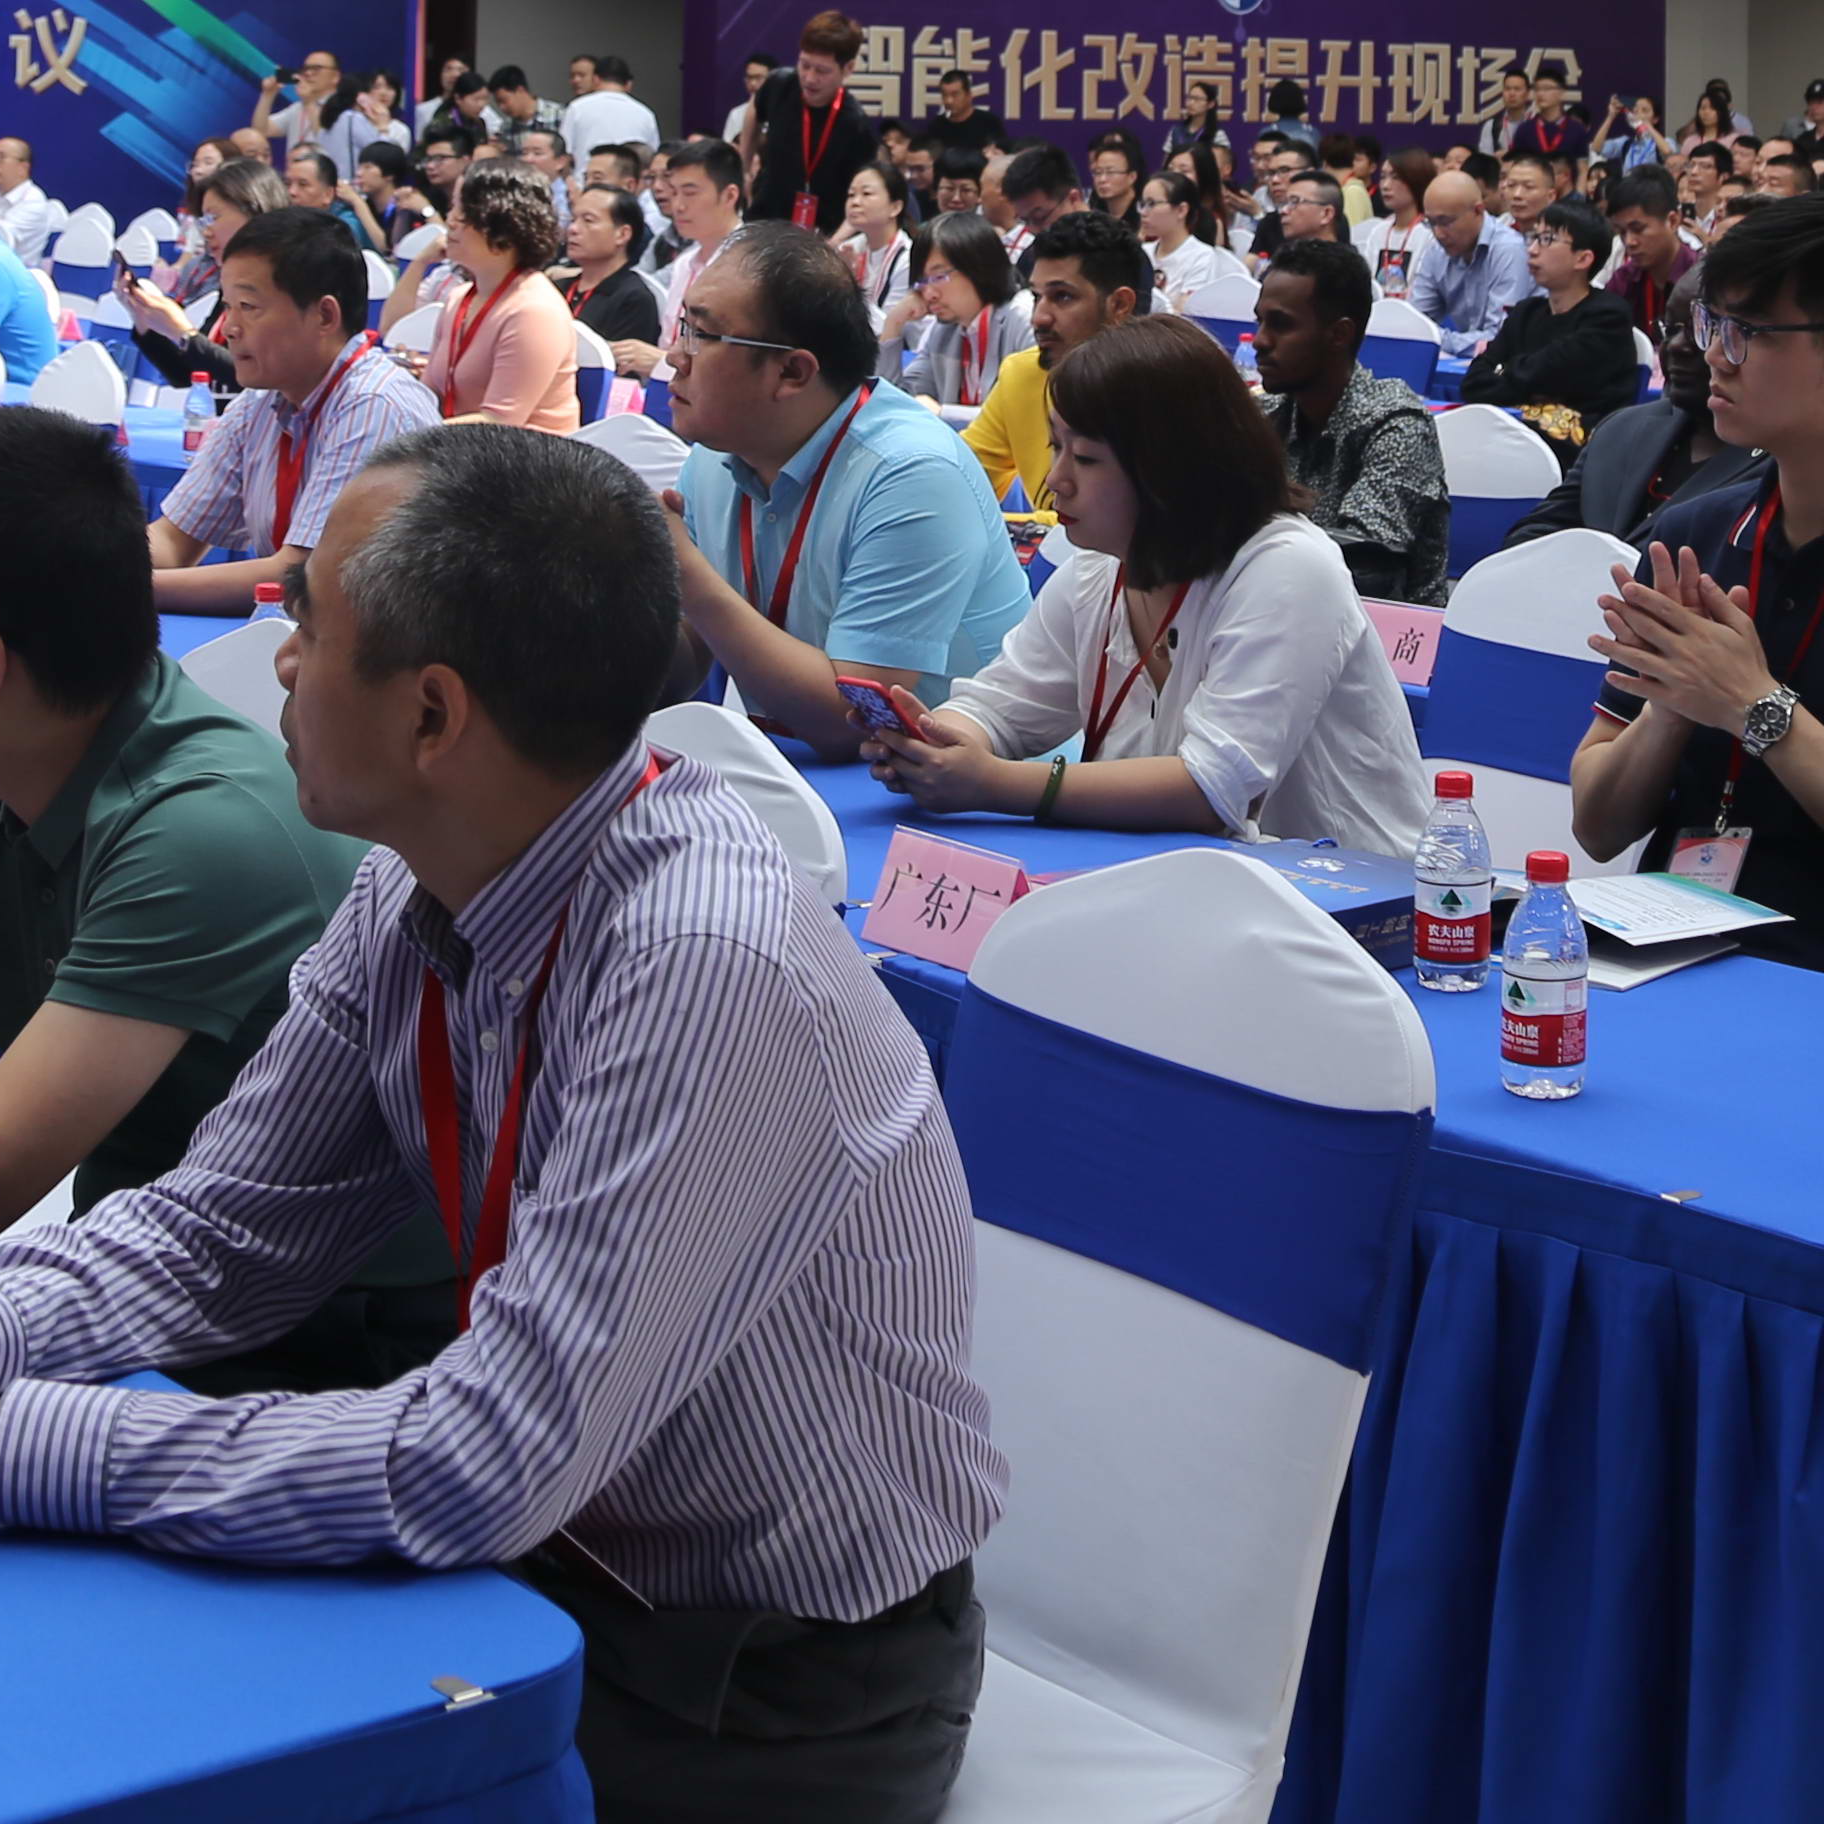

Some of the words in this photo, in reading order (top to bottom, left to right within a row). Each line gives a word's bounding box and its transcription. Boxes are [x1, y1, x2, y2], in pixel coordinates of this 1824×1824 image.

[877, 862, 1002, 934] 广东厂
[1428, 924, 1475, 939] 农夫山泉
